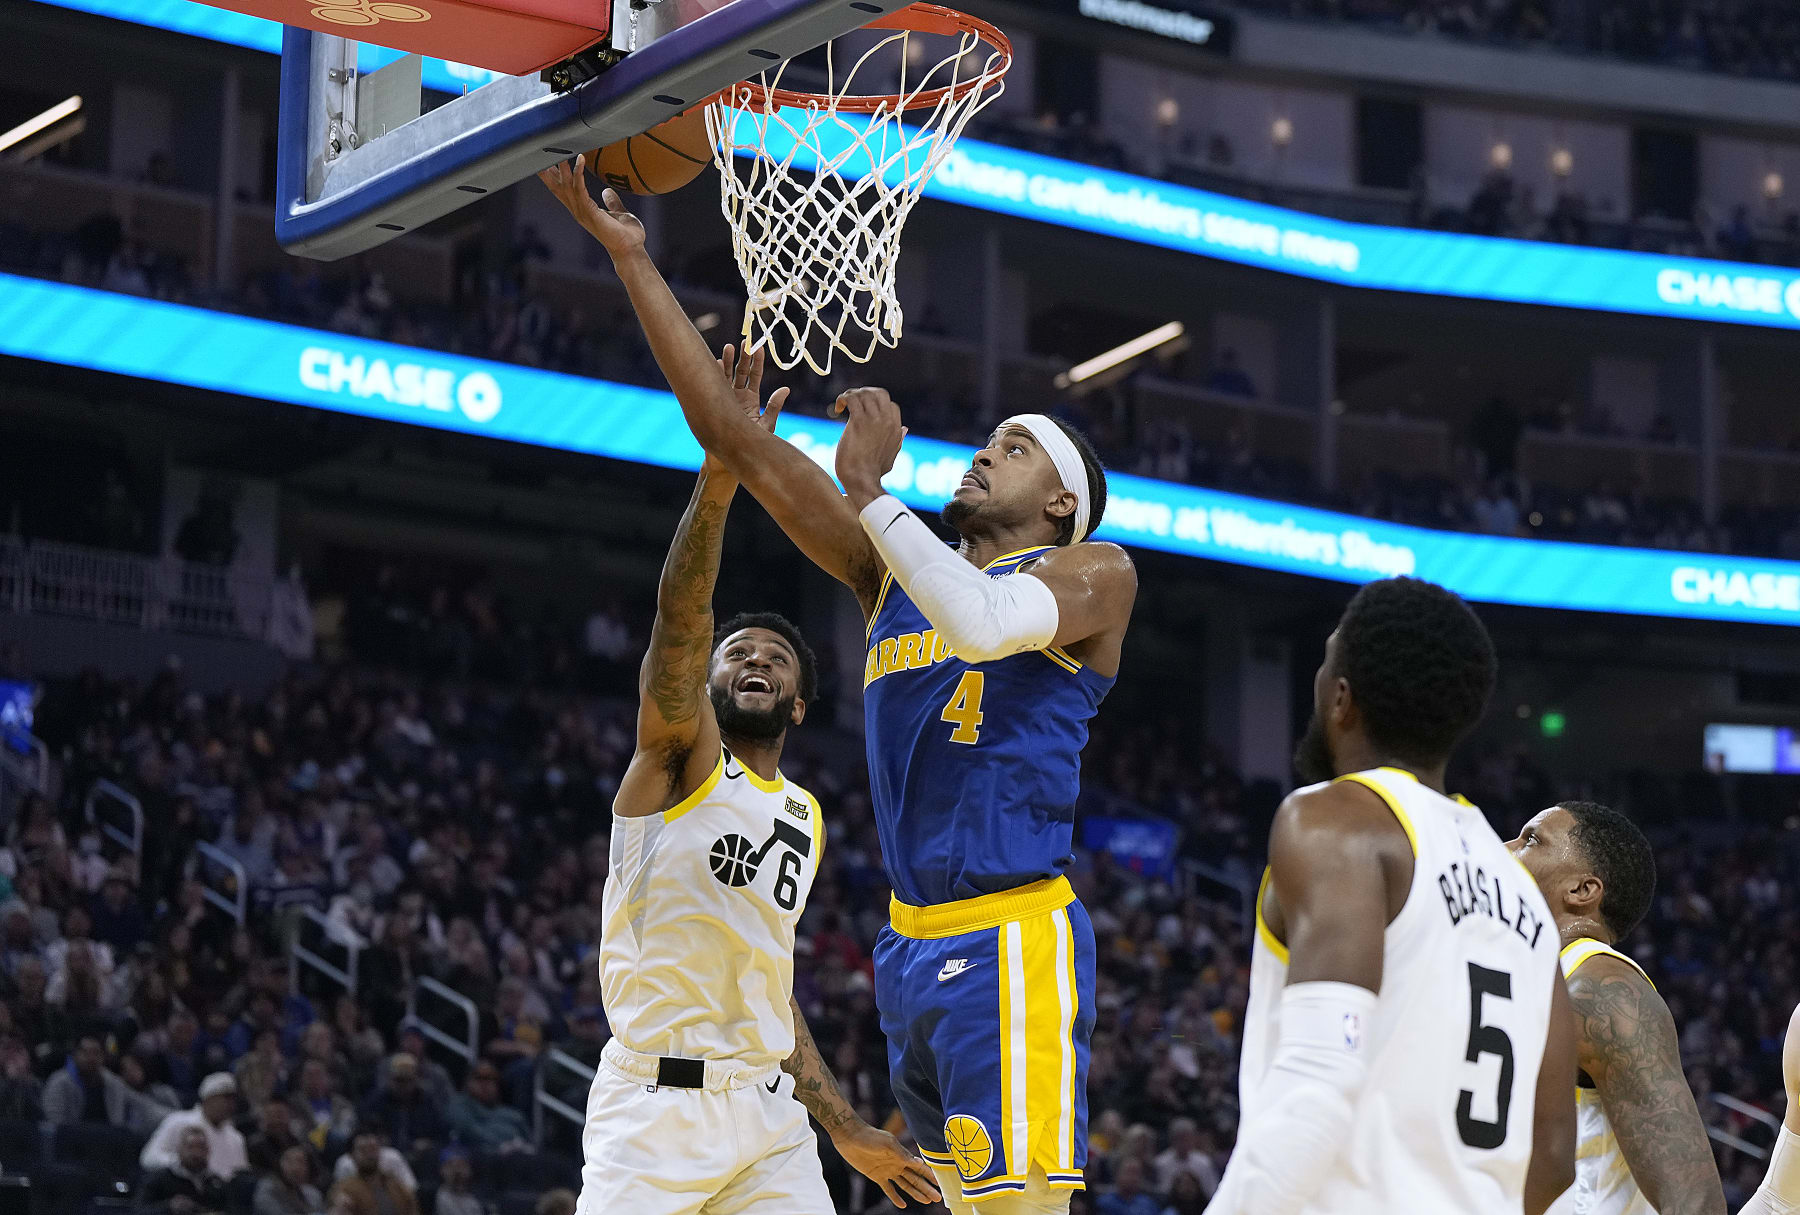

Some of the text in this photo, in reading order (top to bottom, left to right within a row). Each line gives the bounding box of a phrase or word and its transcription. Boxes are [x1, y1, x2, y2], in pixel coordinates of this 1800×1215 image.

[1028, 174, 1201, 239] cardholders
[1202, 212, 1280, 256] score
[1280, 229, 1360, 272] more
[1657, 268, 1783, 314] CHASE
[299, 347, 454, 412] CHASE
[1209, 507, 1340, 565] Warriors
[1671, 566, 1800, 611] CHASE
[863, 629, 957, 693] ARRIO
[941, 670, 984, 745] 4
[774, 851, 801, 911] 6
[1438, 862, 1543, 949] BEASLEY
[943, 958, 969, 972] NIKE
[1456, 961, 1514, 1149] 5
